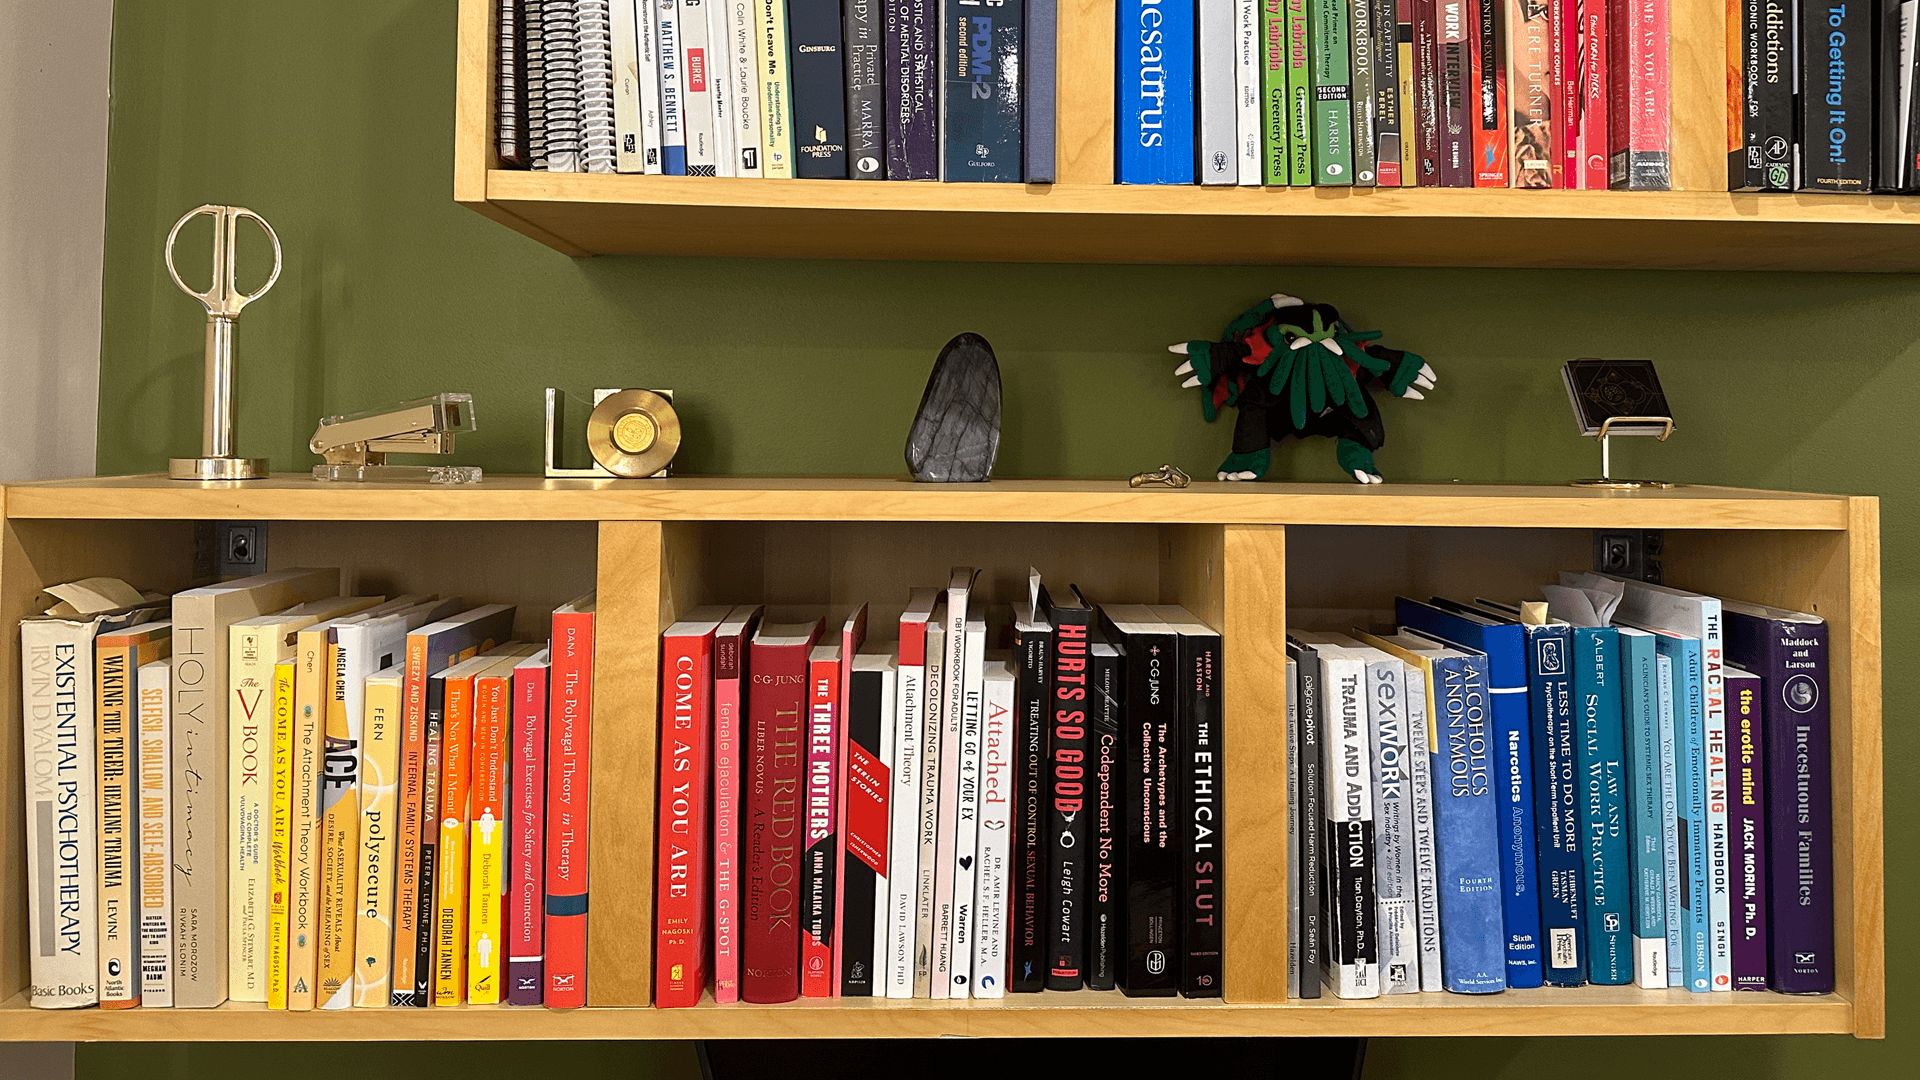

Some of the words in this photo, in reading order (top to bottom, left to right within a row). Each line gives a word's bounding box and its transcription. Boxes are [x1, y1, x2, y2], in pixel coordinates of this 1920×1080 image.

[736, 3, 745, 26] Colin
[900, 6, 909, 21] OF
[959, 17, 968, 46] second
[1243, 5, 1252, 29] Work
[1829, 4, 1845, 27] To
[661, 21, 674, 69] MATTHEW
[738, 28, 746, 54] White
[900, 24, 910, 64] MENTAL
[971, 17, 992, 100] PDM-2
[1243, 31, 1252, 66] Practice
[1269, 19, 1283, 71] Labriola
[664, 74, 675, 83] S.
[692, 57, 702, 83] BURKE
[768, 60, 776, 75] Me
[851, 45, 864, 91] Practice
[866, 45, 880, 86] Private
[958, 48, 968, 77] edition
[1826, 31, 1846, 105] Getting
[665, 88, 677, 132] BENNETT
[741, 96, 750, 130] Boucke
[900, 66, 910, 124] DISORDERS
[1270, 88, 1282, 143] Greenery
[861, 100, 873, 149] MARRA
[1327, 110, 1340, 155] HARRIS
[1830, 110, 1846, 124] It
[1273, 146, 1283, 177] Press
[1830, 128, 1846, 163] On!
[567, 628, 575, 657] DANA
[1708, 615, 1718, 640] THE
[103, 655, 124, 707] WAKING
[178, 628, 204, 724] HOLY
[306, 651, 315, 673] Chen
[336, 646, 346, 678] ANGELA
[566, 670, 578, 695] The
[1057, 624, 1086, 700] HURTS
[1595, 637, 1604, 686] ALBERT
[335, 680, 345, 701] CHEN
[675, 656, 693, 729] COME
[817, 679, 828, 697] THE
[1708, 649, 1722, 719] RACIAL
[1740, 689, 1753, 715] the
[55, 644, 77, 776] EXISTENTIAL
[103, 711, 121, 734] THE
[141, 688, 162, 736] SELFISH,
[374, 708, 384, 740] FERN
[560, 699, 577, 755] Polyvagal
[813, 702, 831, 753] THREE
[904, 675, 917, 742] Attachment
[928, 665, 939, 753] DECOLONIZING
[965, 691, 978, 736] LETTING
[1056, 710, 1084, 739] SO
[1341, 674, 1358, 739] TRAUMA
[1586, 694, 1598, 756] SOCIAL
[303, 722, 314, 745] The
[757, 721, 765, 752] LIBER
[774, 701, 799, 768] THE
[964, 742, 976, 755] GO
[986, 701, 1008, 804] Attached
[1198, 722, 1208, 745] THE
[1443, 667, 1471, 798] ANONYMOUS
[1463, 667, 1488, 797] ALCOHOLICS
[1741, 719, 1754, 764] erotic
[103, 737, 124, 781] TIGER:
[141, 739, 163, 794] SHALLOW,
[242, 726, 258, 786] BOOK
[324, 736, 358, 790] ACE
[407, 751, 418, 798] INTERNAL
[674, 740, 691, 772] AS
[755, 755, 764, 794] NOVUS
[900, 745, 915, 786] Theory
[963, 760, 976, 774] of
[1344, 744, 1359, 777] AND
[1509, 730, 1522, 802] Narcotics
[1709, 730, 1724, 812] HEALING
[1797, 726, 1810, 823] Incestuous
[301, 748, 313, 818] Attachment
[559, 759, 576, 804] Theory
[811, 761, 830, 839] MOTHERS
[926, 758, 935, 805] TRAUMA
[962, 777, 975, 802] YOUR
[1054, 748, 1084, 812] GOOD
[1097, 734, 1114, 833] Codependent
[1589, 761, 1602, 815] WORK
[1607, 760, 1619, 798] LAW
[1742, 768, 1755, 805] mind
[104, 785, 122, 834] HEALING
[143, 797, 163, 819] AND
[173, 729, 203, 887] intimacy
[404, 801, 417, 837] FAMILY
[562, 813, 573, 825] in
[672, 781, 689, 834] YOU
[772, 776, 796, 838] RED
[961, 807, 973, 820] EX
[1195, 752, 1213, 853] ETHICAL
[1607, 803, 1620, 838] AND
[297, 821, 311, 864] Theory
[924, 809, 933, 845] WORK
[1347, 783, 1363, 867] ADDICTION
[1743, 818, 1754, 850] JACK
[58, 781, 81, 956] PSYCHOTHERAPY
[104, 837, 122, 888] TRAUMA
[143, 822, 165, 909] SELF-ABSORBED
[365, 811, 385, 918] polysecure
[404, 839, 415, 884] SYSTEMS
[424, 850, 432, 876] PETER
[558, 829, 574, 881] Therapy
[813, 851, 823, 874] ANNA
[1099, 837, 1112, 859] No
[1591, 822, 1605, 906] PRACTICE
[1713, 823, 1725, 894] HANDBOOK
[1798, 831, 1813, 906] Families
[423, 879, 430, 889] A.
[670, 844, 688, 897] ARE
[768, 844, 794, 934] BOOK
[1061, 861, 1073, 895] Leigh
[1098, 863, 1112, 902] More
[1743, 853, 1755, 899] MORIN,
[298, 867, 310, 930] Workbook
[402, 888, 413, 931] THERAPY
[421, 893, 430, 928] LEVINE,
[812, 878, 823, 916] MALAIKA
[1195, 861, 1213, 926] SLUT
[1745, 903, 1756, 923] Ph.
[190, 908, 198, 931] SARA
[441, 908, 454, 946] DEBORAH
[811, 918, 822, 947] TUBBS
[958, 904, 968, 944] Warren
[1061, 900, 1073, 943] Cowart
[1309, 928, 1317, 948] Seán
[1717, 921, 1725, 957] SINGH
[1746, 927, 1756, 940] D.
[420, 931, 429, 956] PH.D.
[440, 948, 452, 980] TANNEN
[1307, 949, 1316, 964] Foy
[1695, 932, 1705, 972] GIBSON
[30, 985, 54, 997] Basic
[58, 982, 94, 996] Books
